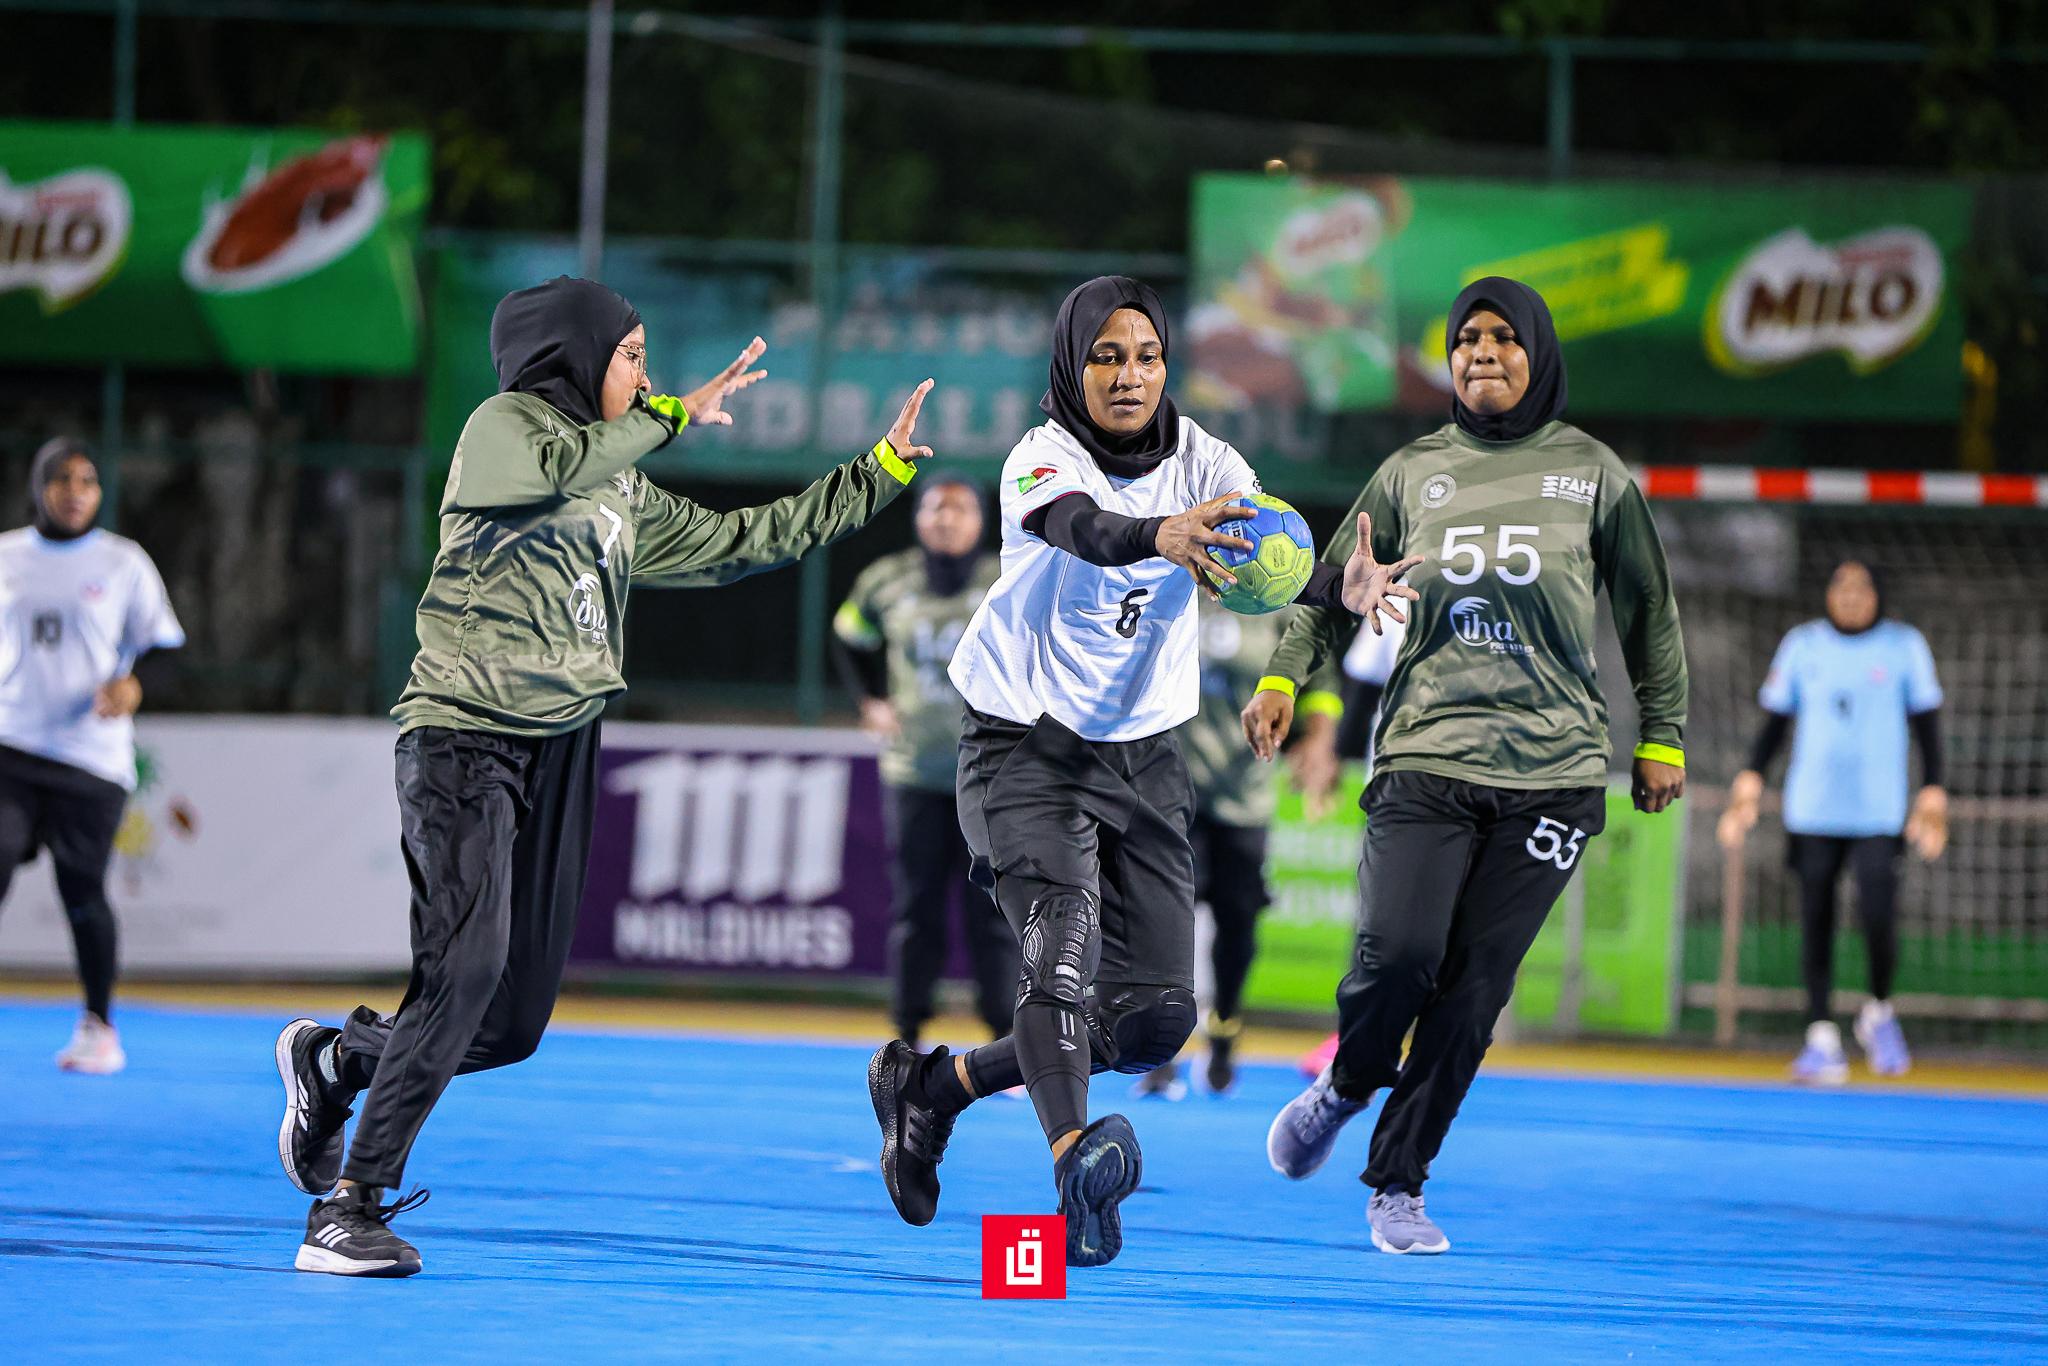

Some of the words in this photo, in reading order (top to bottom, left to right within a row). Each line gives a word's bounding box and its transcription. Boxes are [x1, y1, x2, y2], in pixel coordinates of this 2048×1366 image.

[0, 208, 107, 265] ILO
[1744, 270, 1918, 336] MILO
[599, 502, 623, 568] 7
[1441, 525, 1541, 585] 55
[31, 608, 62, 650] 10
[1116, 588, 1148, 638] 6
[1463, 613, 1518, 641] iha
[1526, 816, 1586, 870] 55
[612, 900, 854, 968] MALDIVES
